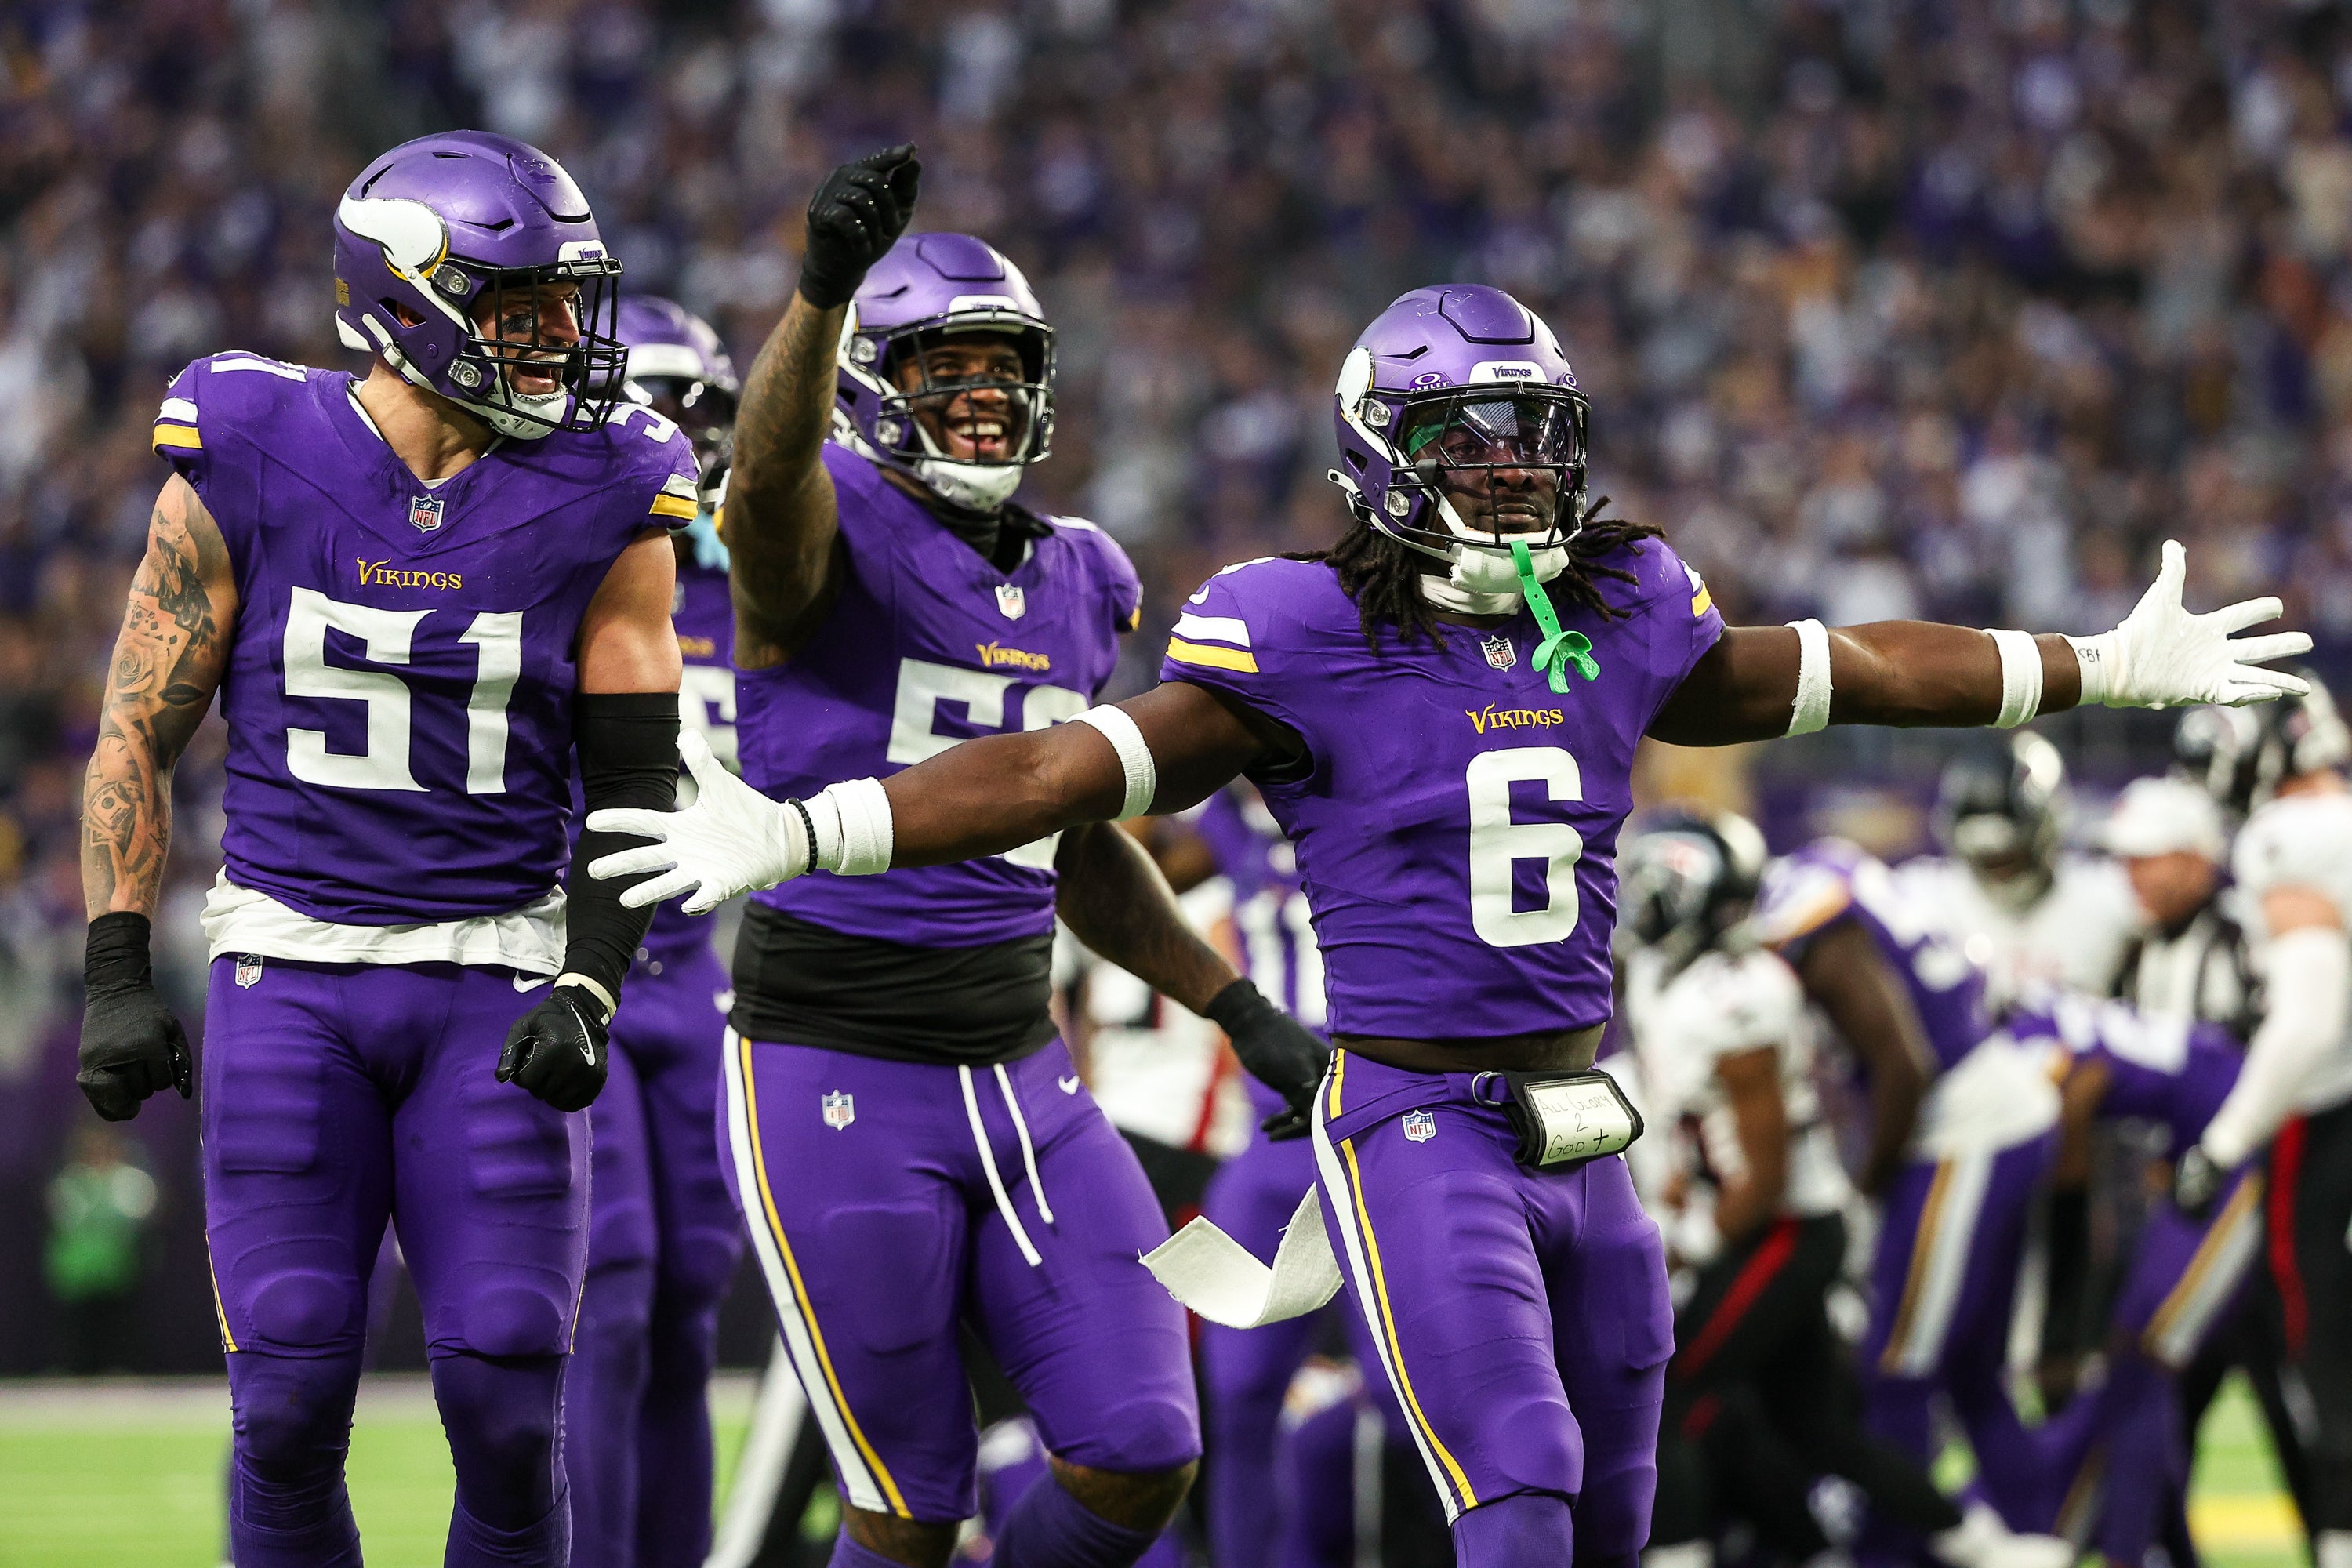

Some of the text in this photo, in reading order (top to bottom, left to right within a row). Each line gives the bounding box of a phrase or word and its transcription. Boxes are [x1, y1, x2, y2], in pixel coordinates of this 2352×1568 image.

[415, 510, 436, 526] NFL
[1490, 652, 1512, 665] NFL
[284, 586, 524, 795] 51
[1465, 746, 1584, 948] 6
[1538, 1091, 1613, 1116] ALL GLORY
[1410, 1124, 1431, 1135] NFL
[1574, 1112, 1588, 1133] 2
[1548, 1134, 1585, 1159] GOD
